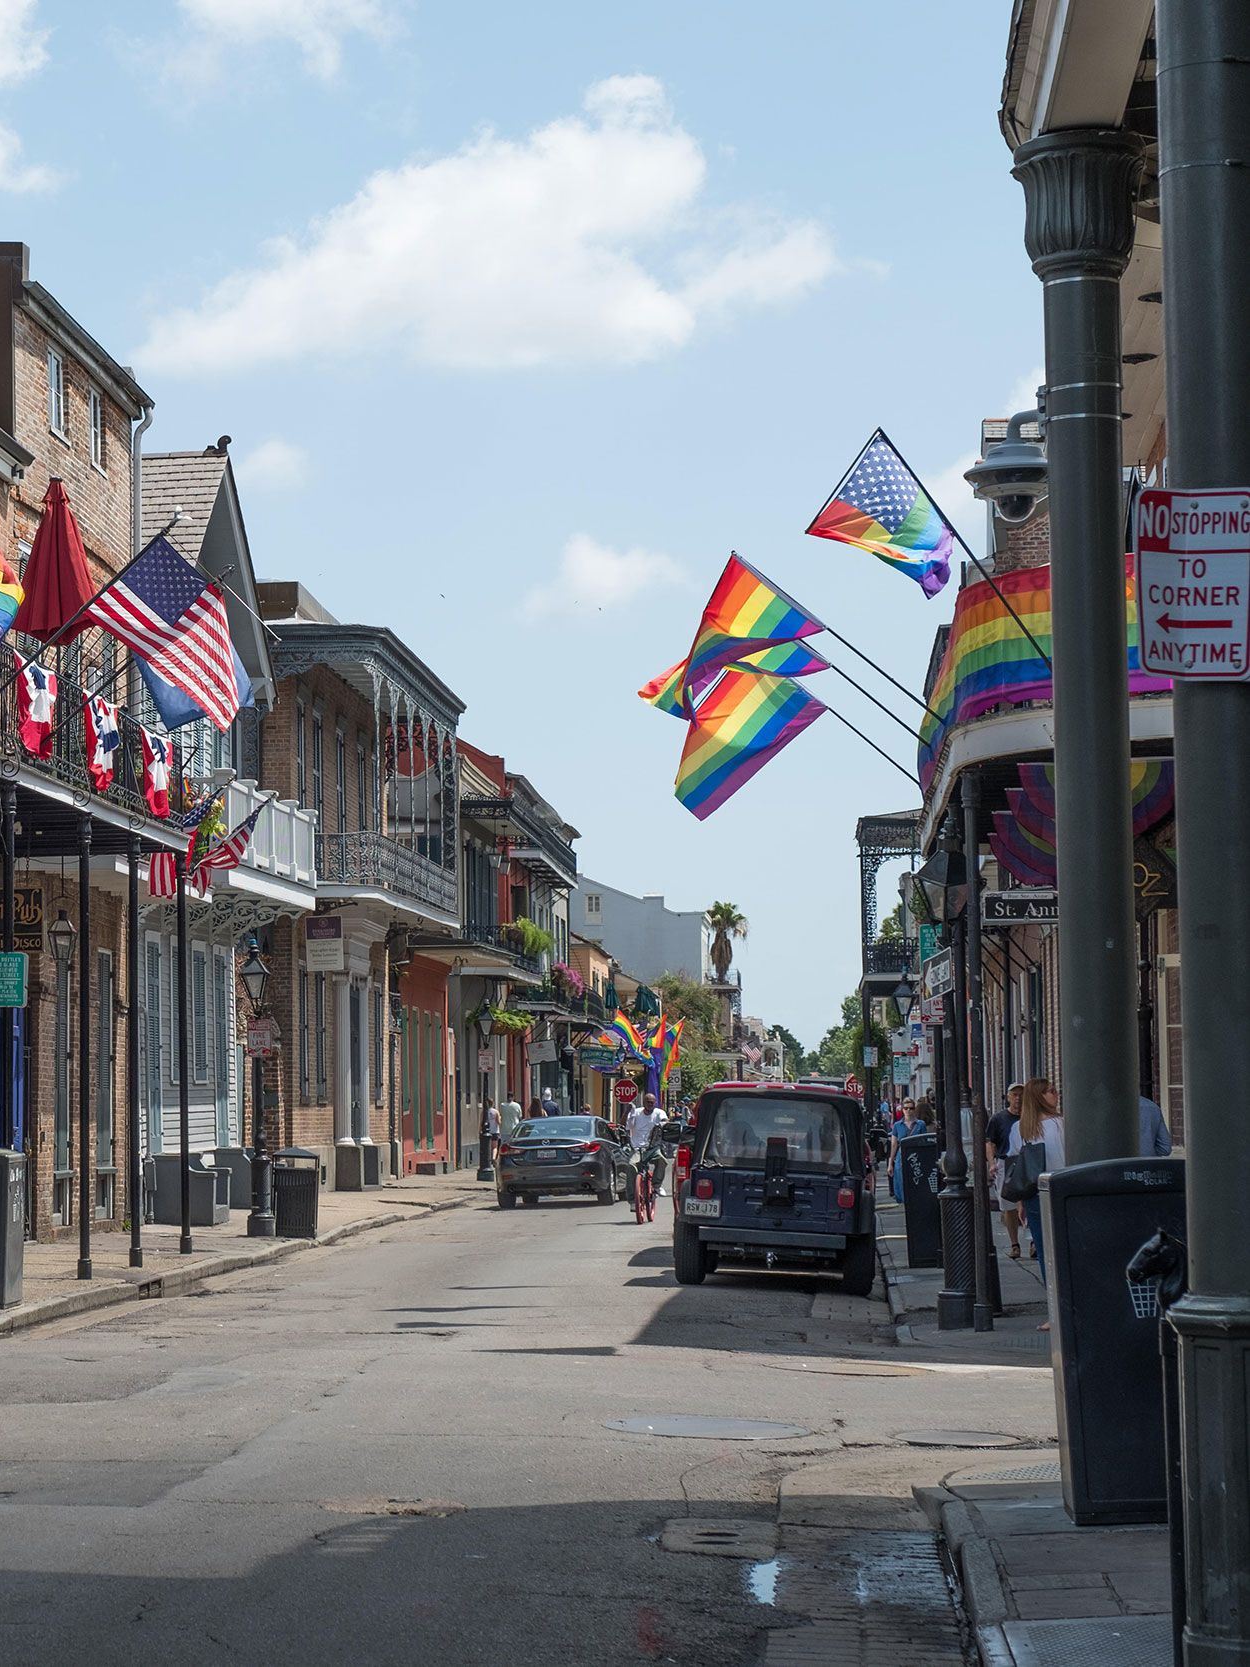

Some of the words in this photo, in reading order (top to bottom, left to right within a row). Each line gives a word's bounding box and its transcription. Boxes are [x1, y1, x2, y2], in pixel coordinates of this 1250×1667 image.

[1139, 501, 1170, 539] NO
[1172, 511, 1250, 535] STOPPING
[1178, 558, 1207, 579] TO
[1148, 584, 1240, 607] CORNER
[1148, 640, 1242, 664] ANYTIME
[994, 901, 1017, 917] St.
[1024, 901, 1060, 918] Ann
[668, 1076, 680, 1084] 20
[615, 1086, 636, 1096] STOP
